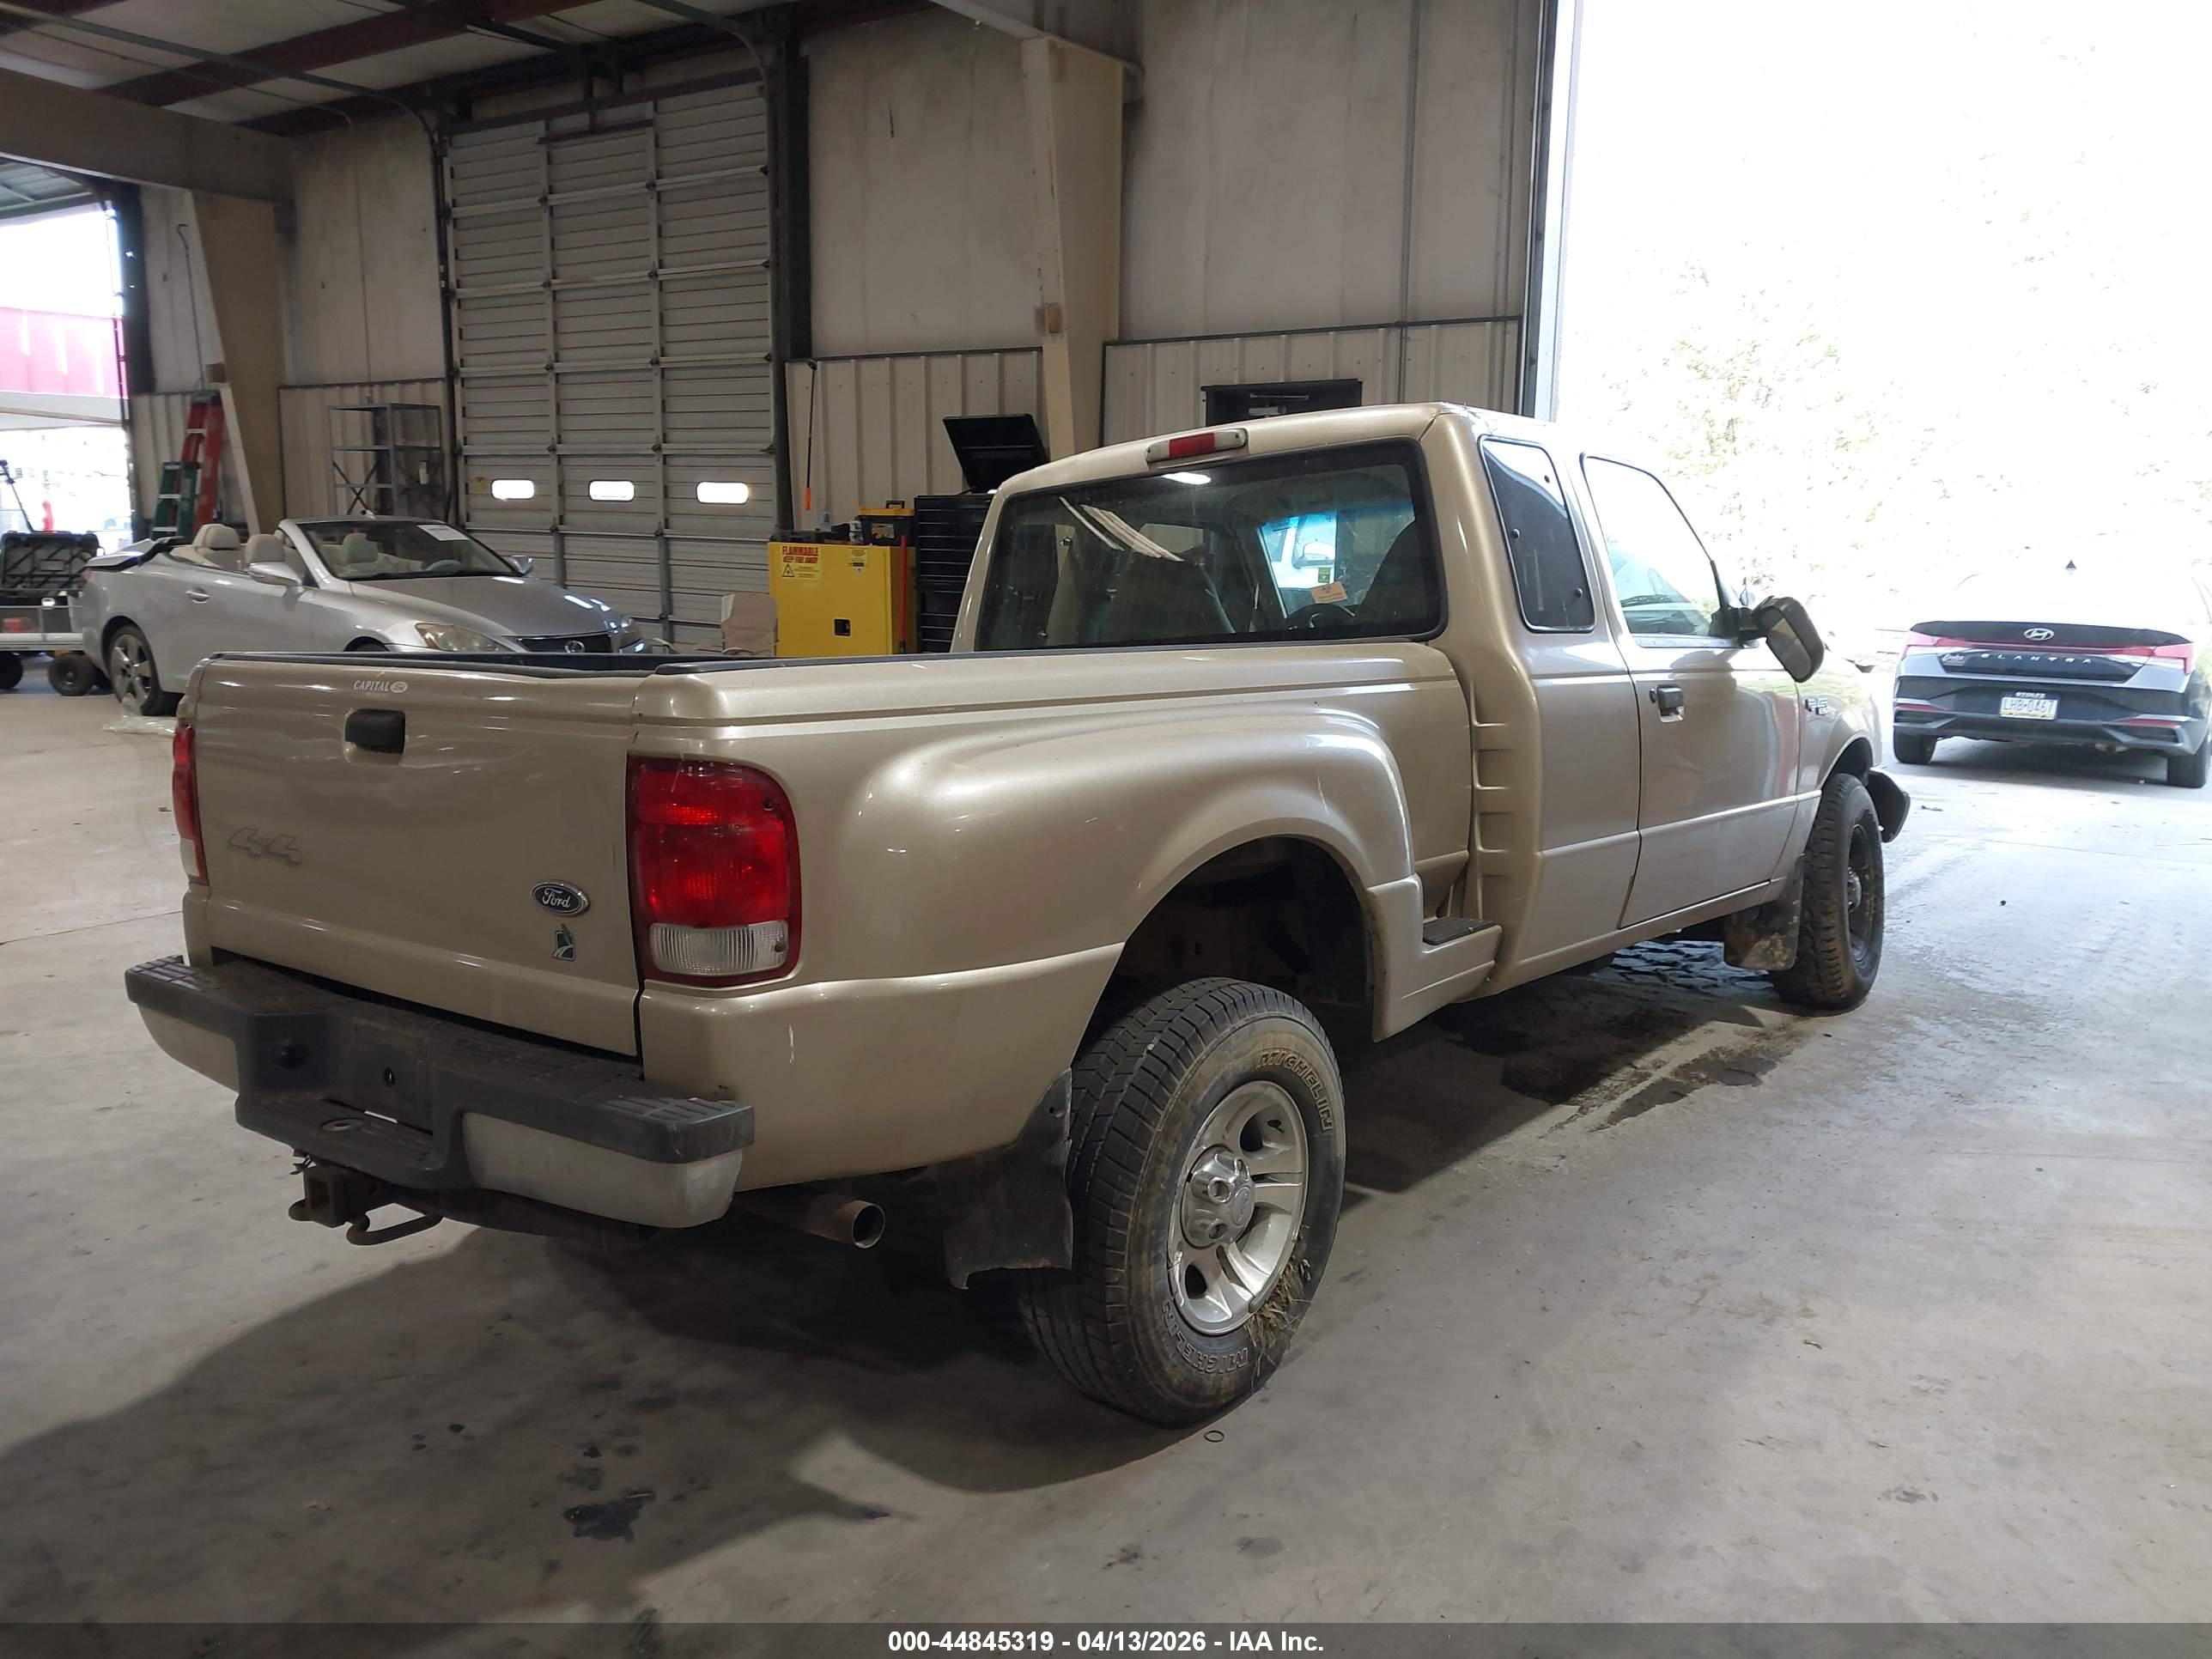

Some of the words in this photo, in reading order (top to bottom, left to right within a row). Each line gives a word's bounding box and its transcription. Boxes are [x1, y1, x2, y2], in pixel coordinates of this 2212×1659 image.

[1980, 653, 2093, 665] ELANTRA
[353, 680, 389, 692] CAPITAL
[542, 887, 571, 908] Ford
[1255, 1049, 1334, 1131] MICHELIN
[1162, 1300, 1249, 1374] MICHELIN
